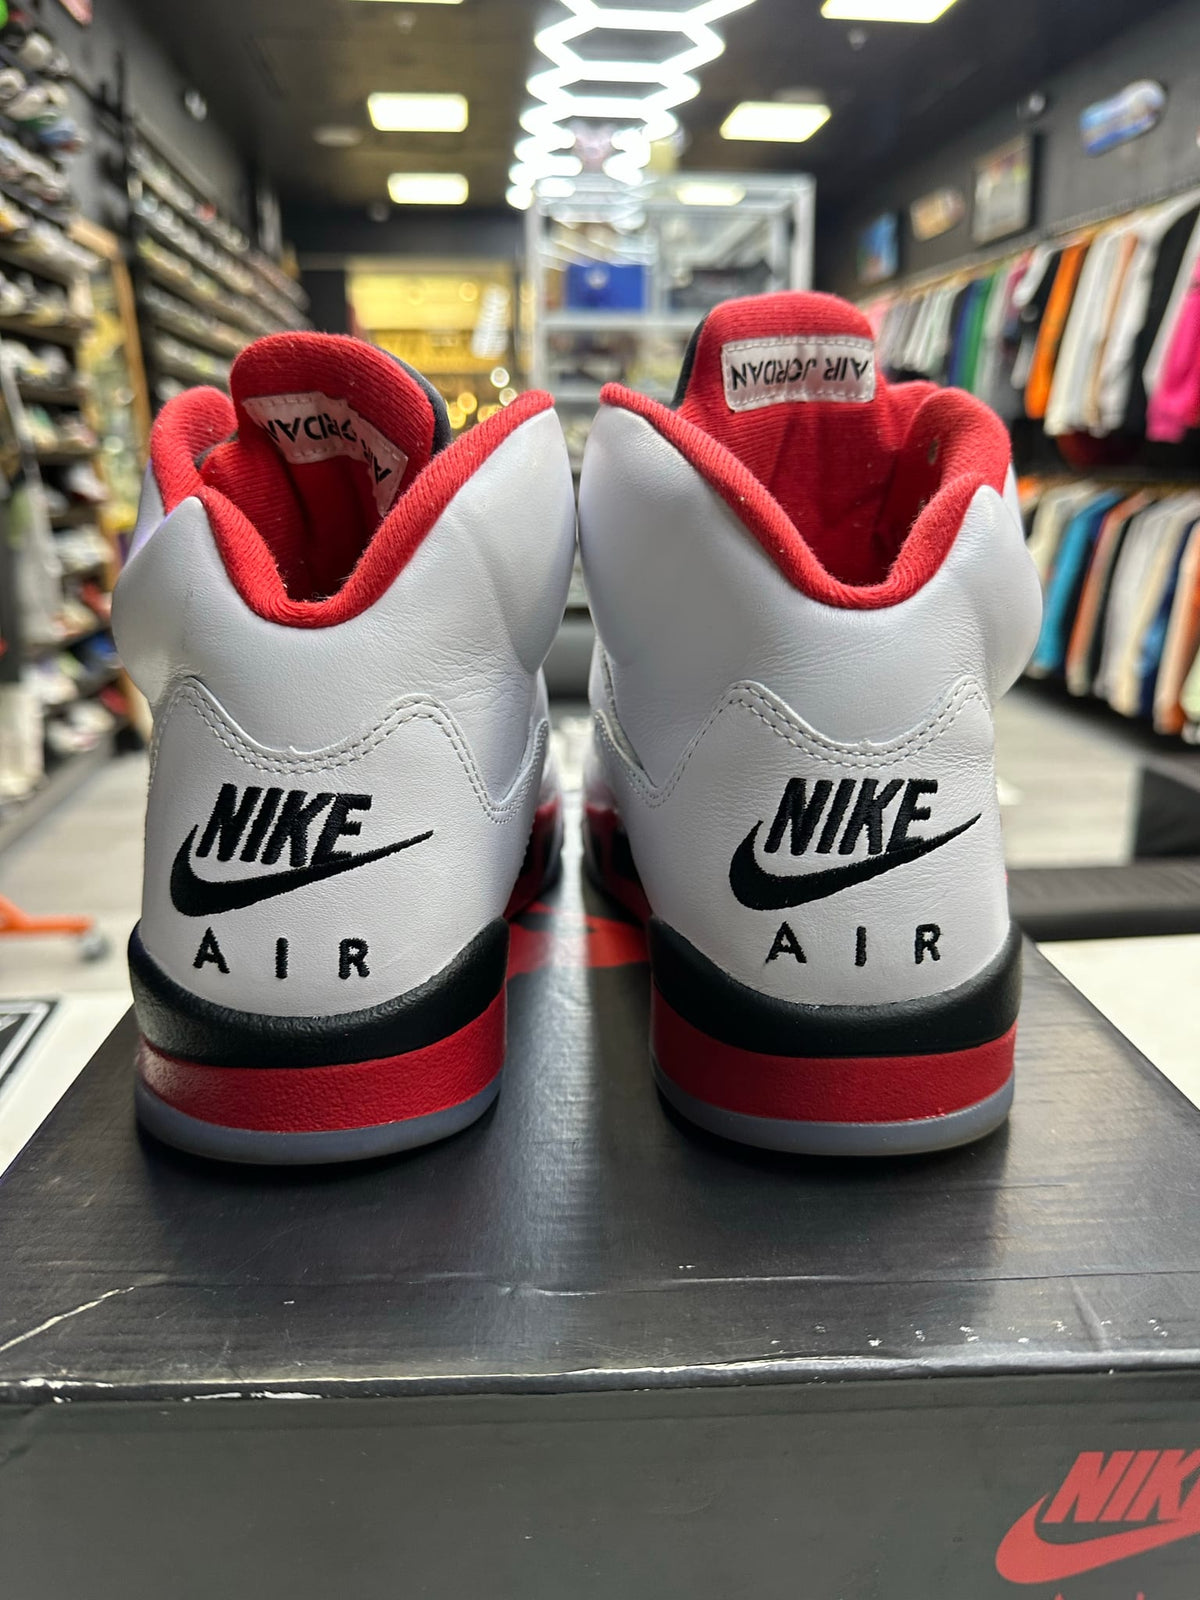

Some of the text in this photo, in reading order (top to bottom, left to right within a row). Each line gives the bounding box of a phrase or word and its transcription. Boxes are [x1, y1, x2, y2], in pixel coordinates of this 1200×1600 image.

[730, 356, 869, 390] AIR JORDAN
[195, 783, 373, 868] NIKE
[764, 777, 939, 856] NIKE
[192, 926, 371, 980] AIR
[764, 920, 944, 968] AIR
[1041, 1448, 1200, 1523] NIK
